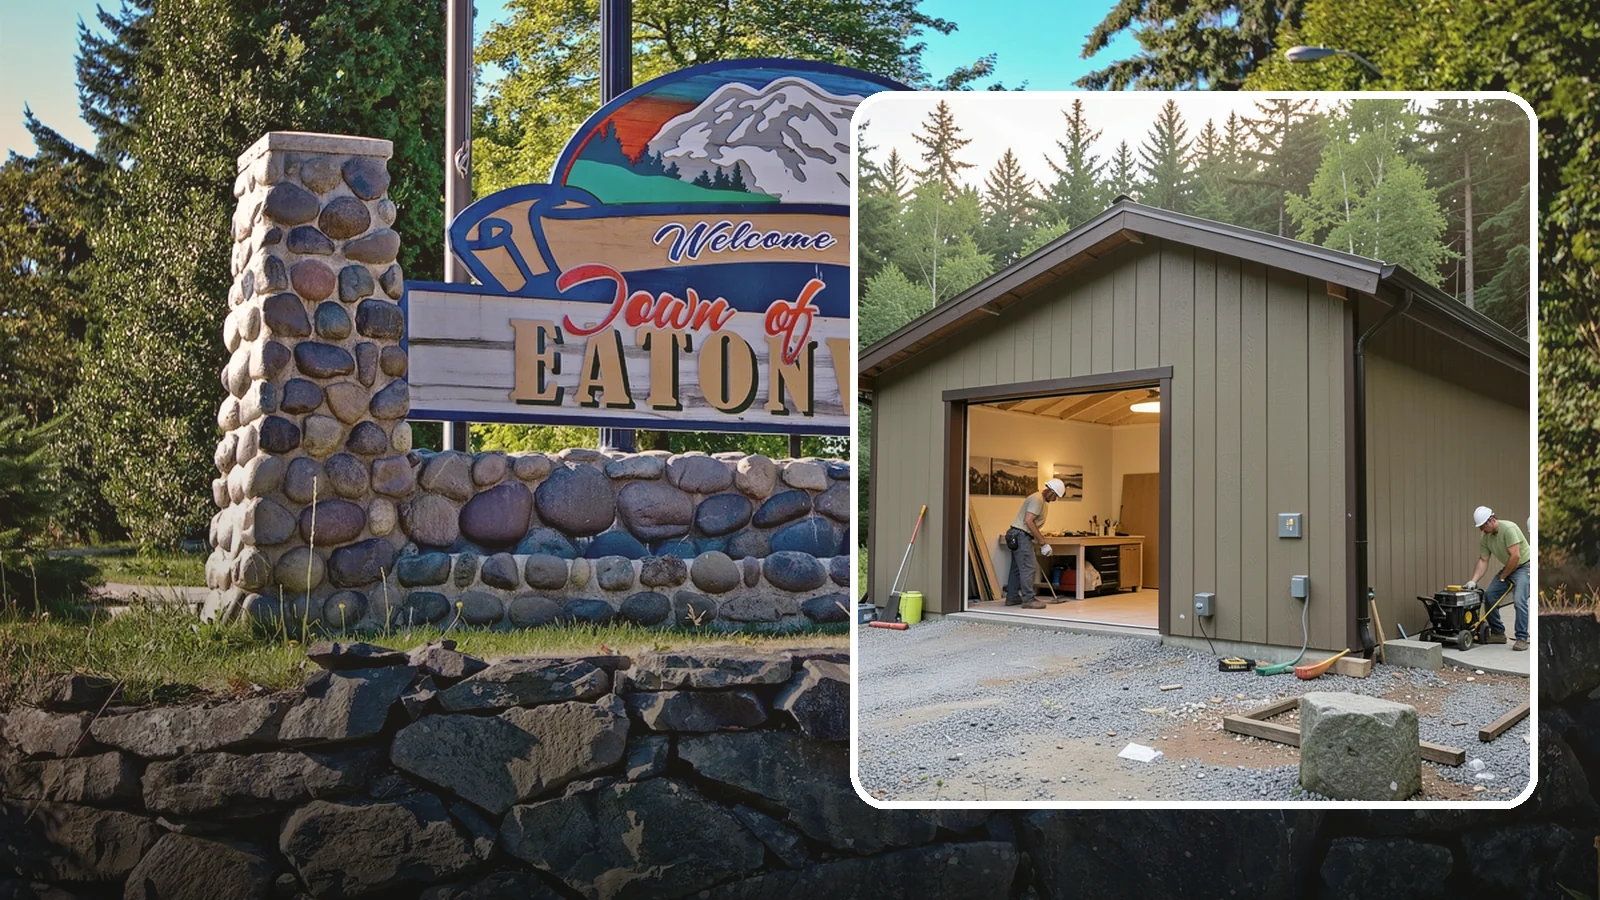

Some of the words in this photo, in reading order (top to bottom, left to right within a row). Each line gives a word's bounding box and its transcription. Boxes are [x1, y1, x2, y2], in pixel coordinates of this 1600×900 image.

[653, 221, 837, 263] Welcome
[556, 263, 737, 336] Town
[764, 278, 826, 365] of
